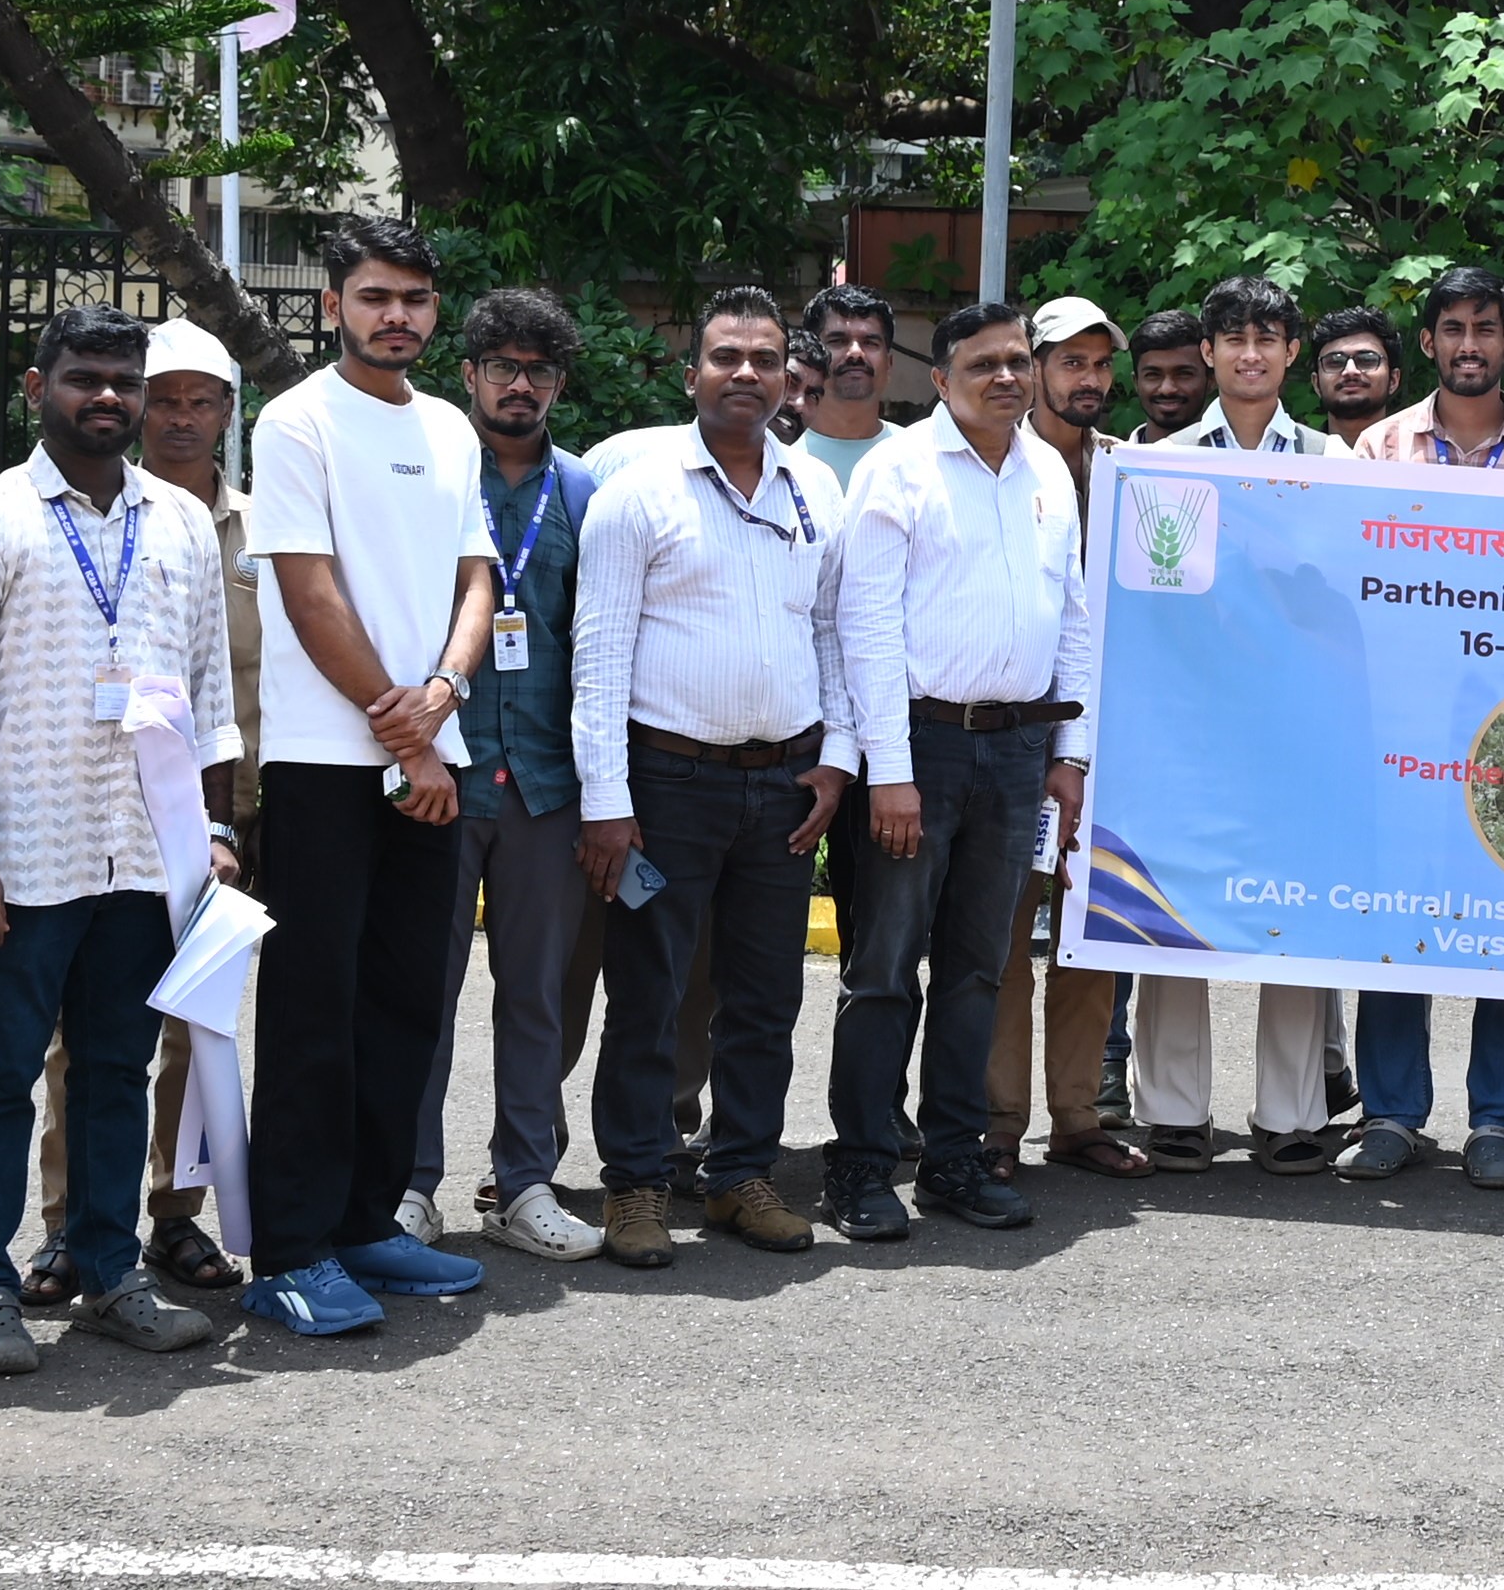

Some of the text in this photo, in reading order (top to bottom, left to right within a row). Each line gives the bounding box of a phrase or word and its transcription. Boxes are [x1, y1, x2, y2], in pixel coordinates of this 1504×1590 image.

[1150, 576, 1184, 587] ICAR
[1034, 813, 1051, 857] Lassi
[1224, 876, 1318, 907] ICAR-
[1328, 883, 1451, 916] Central
